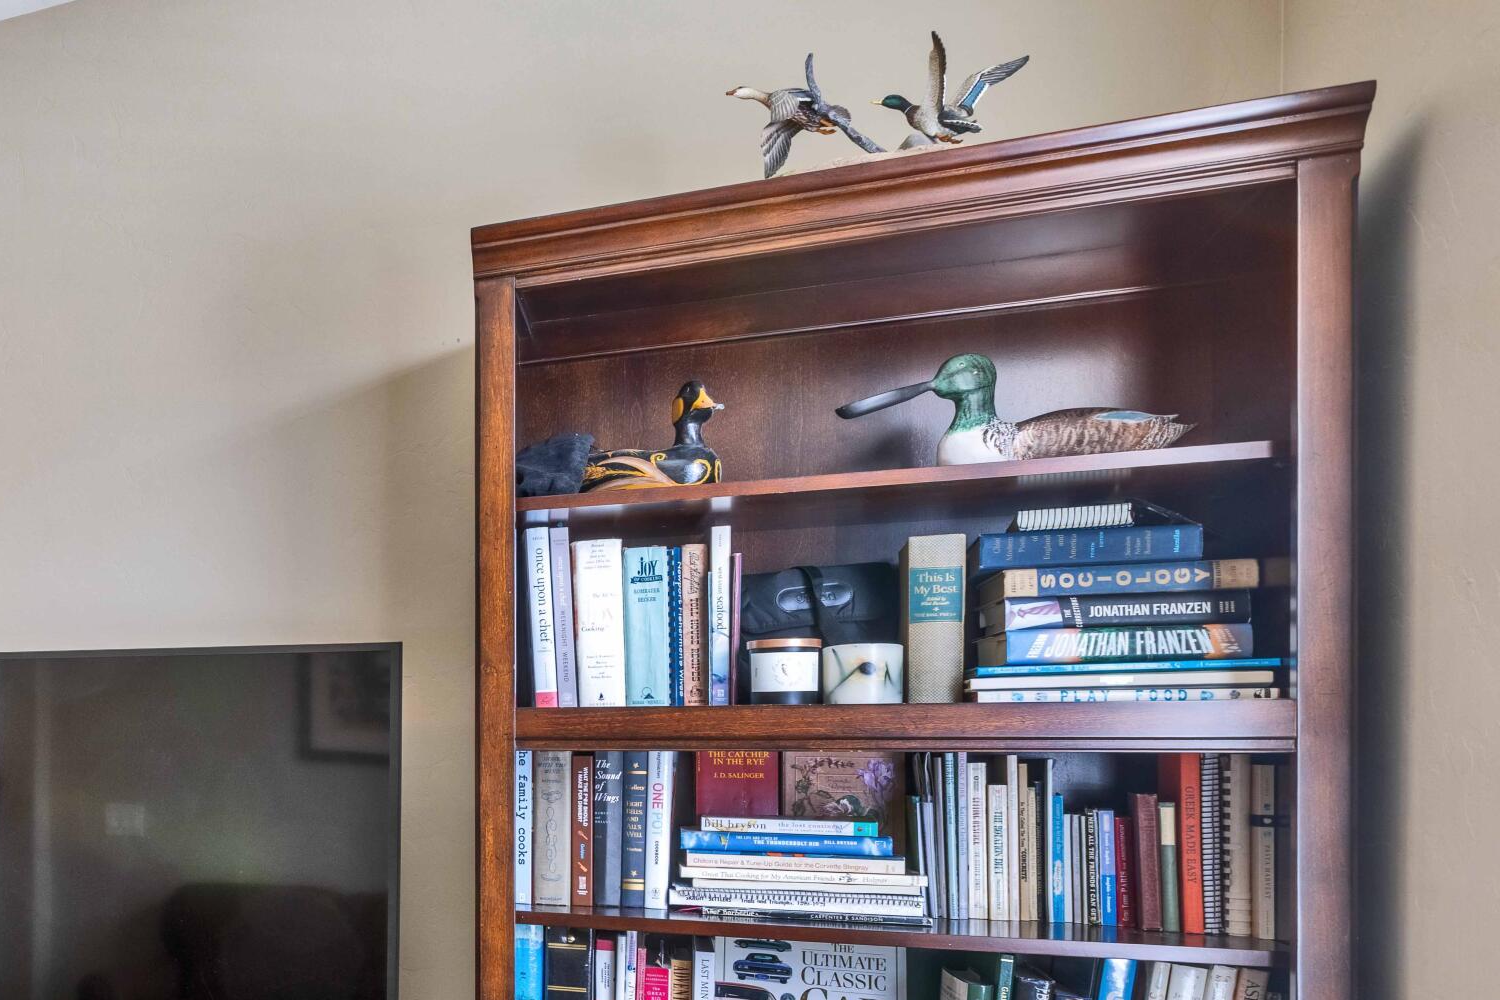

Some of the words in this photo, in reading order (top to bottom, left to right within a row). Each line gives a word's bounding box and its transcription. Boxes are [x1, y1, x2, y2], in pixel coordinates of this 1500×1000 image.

[1043, 534, 1052, 560] England
[1069, 533, 1077, 560] America
[535, 548, 545, 574] once
[916, 571, 942, 582] This
[945, 572, 955, 582] Is
[1040, 567, 1211, 589] SOCIOLOGY
[533, 577, 547, 606] upon
[915, 585, 930, 597] My
[933, 584, 960, 593] Best
[716, 596, 727, 630] seafood
[1089, 603, 1150, 618] JONATHAN
[1153, 601, 1212, 615] FRANZEN
[538, 618, 551, 643] chef
[690, 619, 700, 644] HOUSE
[1044, 631, 1130, 658] JONATHAN
[1135, 628, 1216, 656] FRANZEN
[691, 648, 701, 681] RECIPES
[1060, 690, 1109, 702] PLAY
[1134, 689, 1188, 702] FOOD
[595, 759, 611, 768] The
[595, 771, 622, 780] Sound
[515, 774, 528, 820] family
[595, 781, 607, 791] of
[595, 794, 620, 803] Wings
[652, 783, 664, 810] ONE
[1184, 786, 1195, 820] GREEK
[652, 811, 663, 834] POT
[518, 827, 528, 865] cooks
[1186, 825, 1196, 857] MADE
[735, 872, 759, 880] Cooking
[746, 860, 774, 868] Tune-Up
[1188, 859, 1197, 884] EASY
[801, 951, 887, 971] ULTIMATE
[832, 943, 855, 954] THE
[700, 959, 710, 979] LAST
[801, 966, 887, 992] CLASSIC
